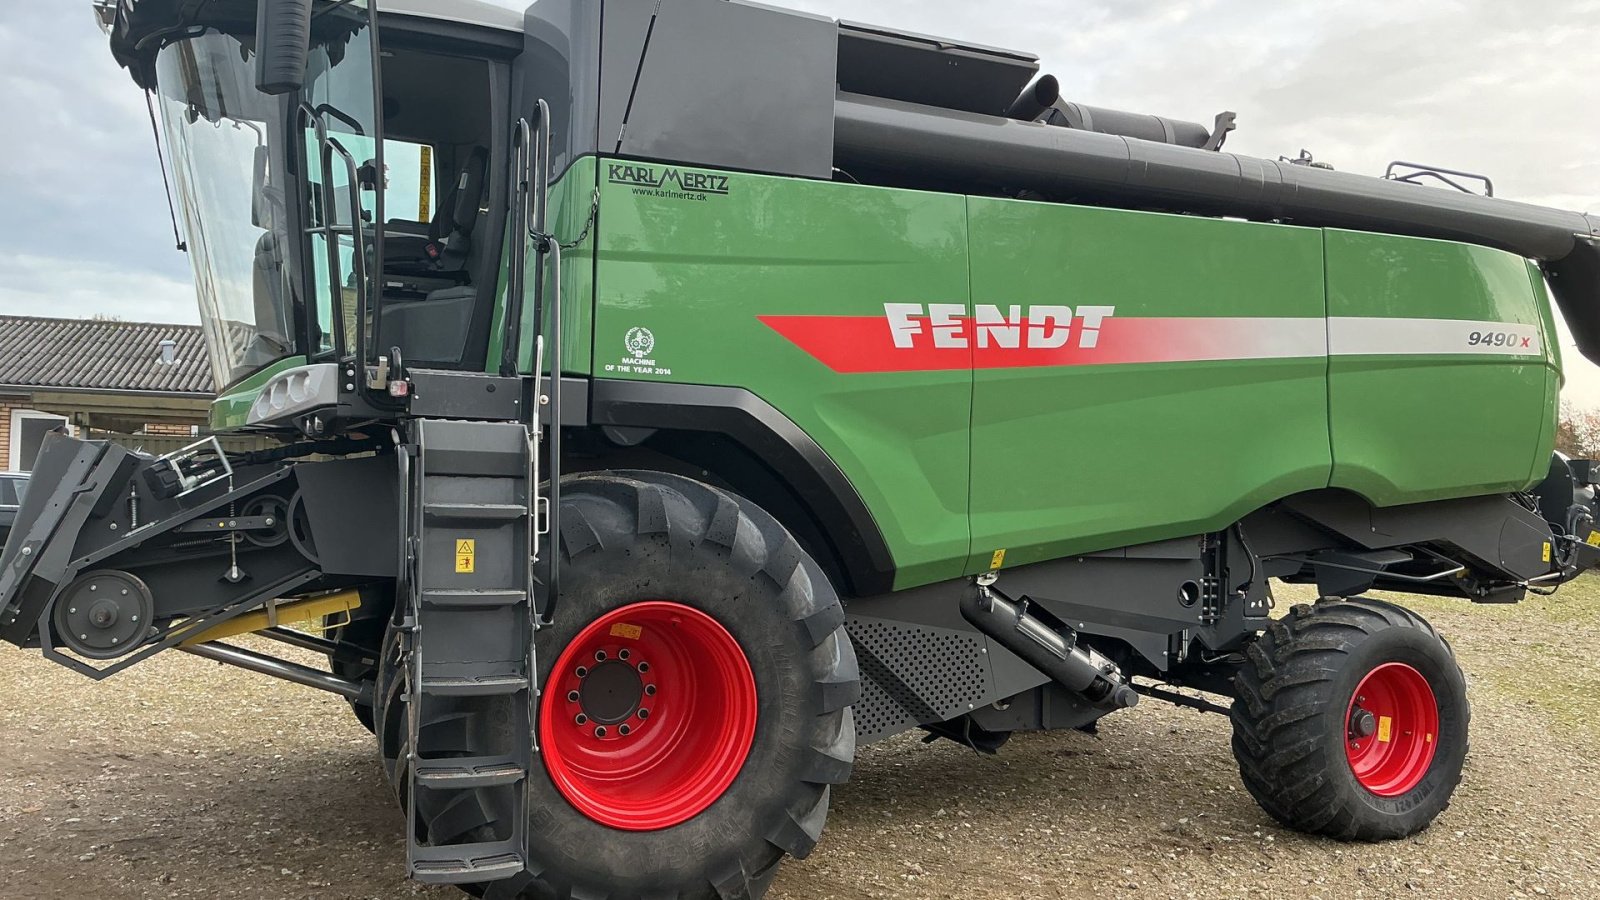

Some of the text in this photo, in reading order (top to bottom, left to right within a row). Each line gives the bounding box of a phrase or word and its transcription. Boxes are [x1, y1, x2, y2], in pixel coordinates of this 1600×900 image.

[608, 164, 657, 182] KARL
[632, 188, 707, 201] www.karlmertz.dk
[883, 303, 1115, 348] FENDT
[1468, 331, 1517, 347] 9490
[622, 357, 655, 366] MACHINE
[633, 366, 652, 374] YEAR
